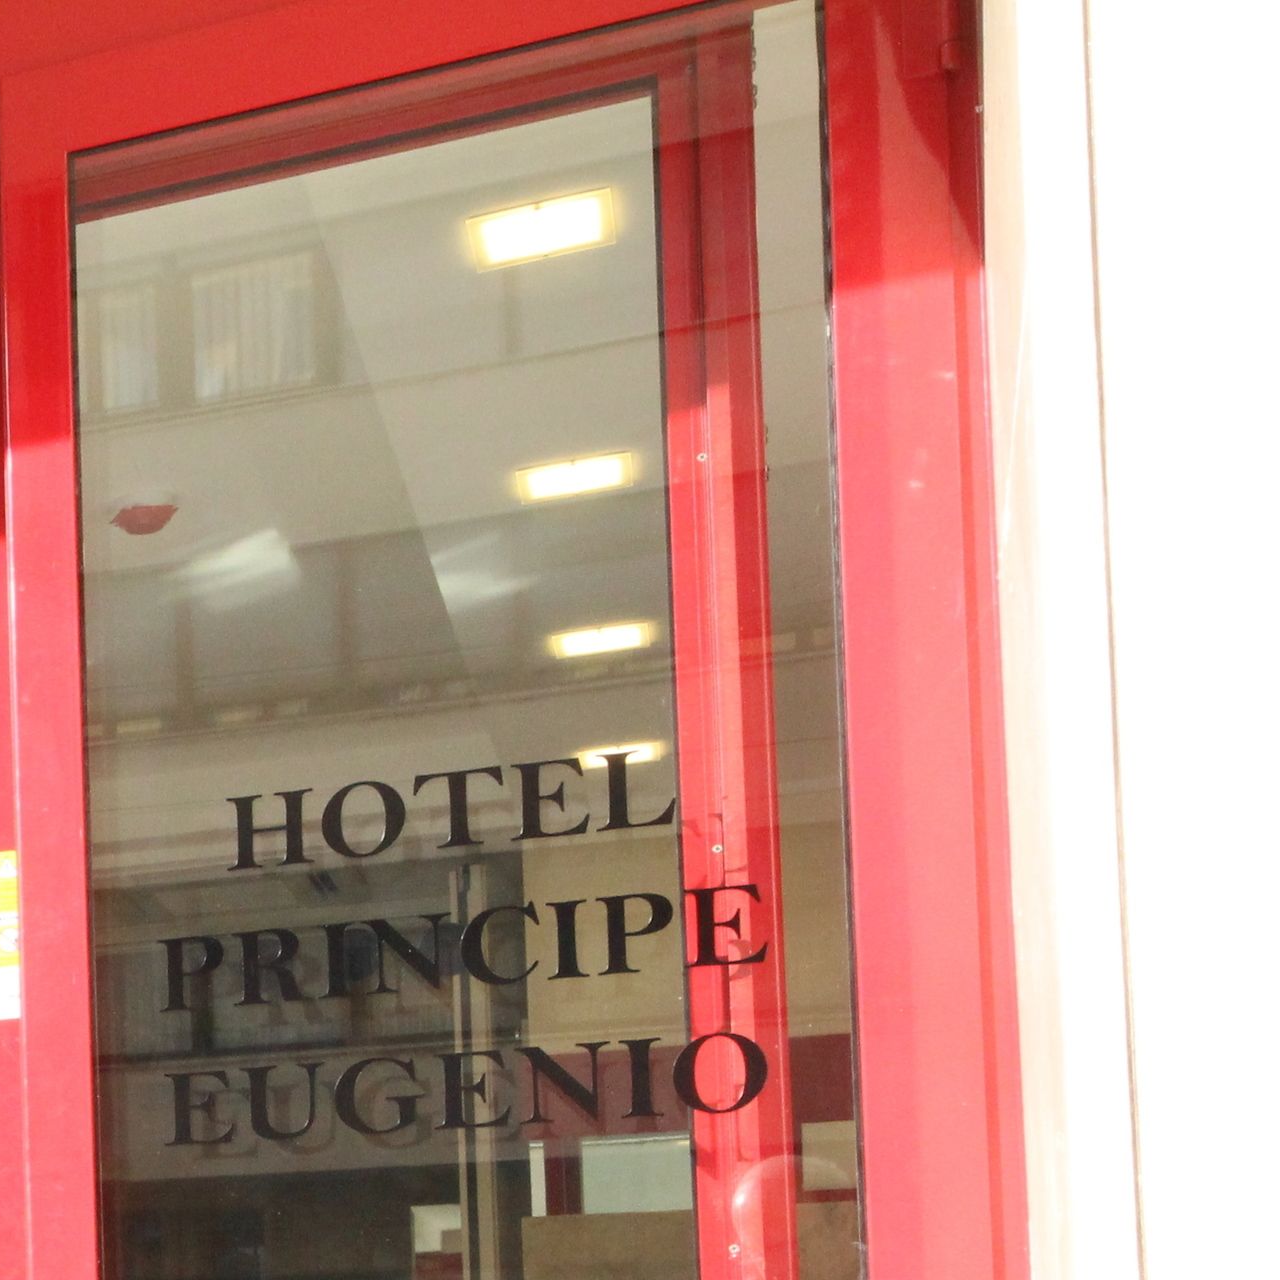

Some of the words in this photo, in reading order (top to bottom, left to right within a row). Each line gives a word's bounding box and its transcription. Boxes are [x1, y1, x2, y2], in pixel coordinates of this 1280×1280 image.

[226, 749, 676, 872] HOTEL
[157, 883, 767, 1012] PRINCIPE
[163, 1032, 769, 1147] EUGENIO
